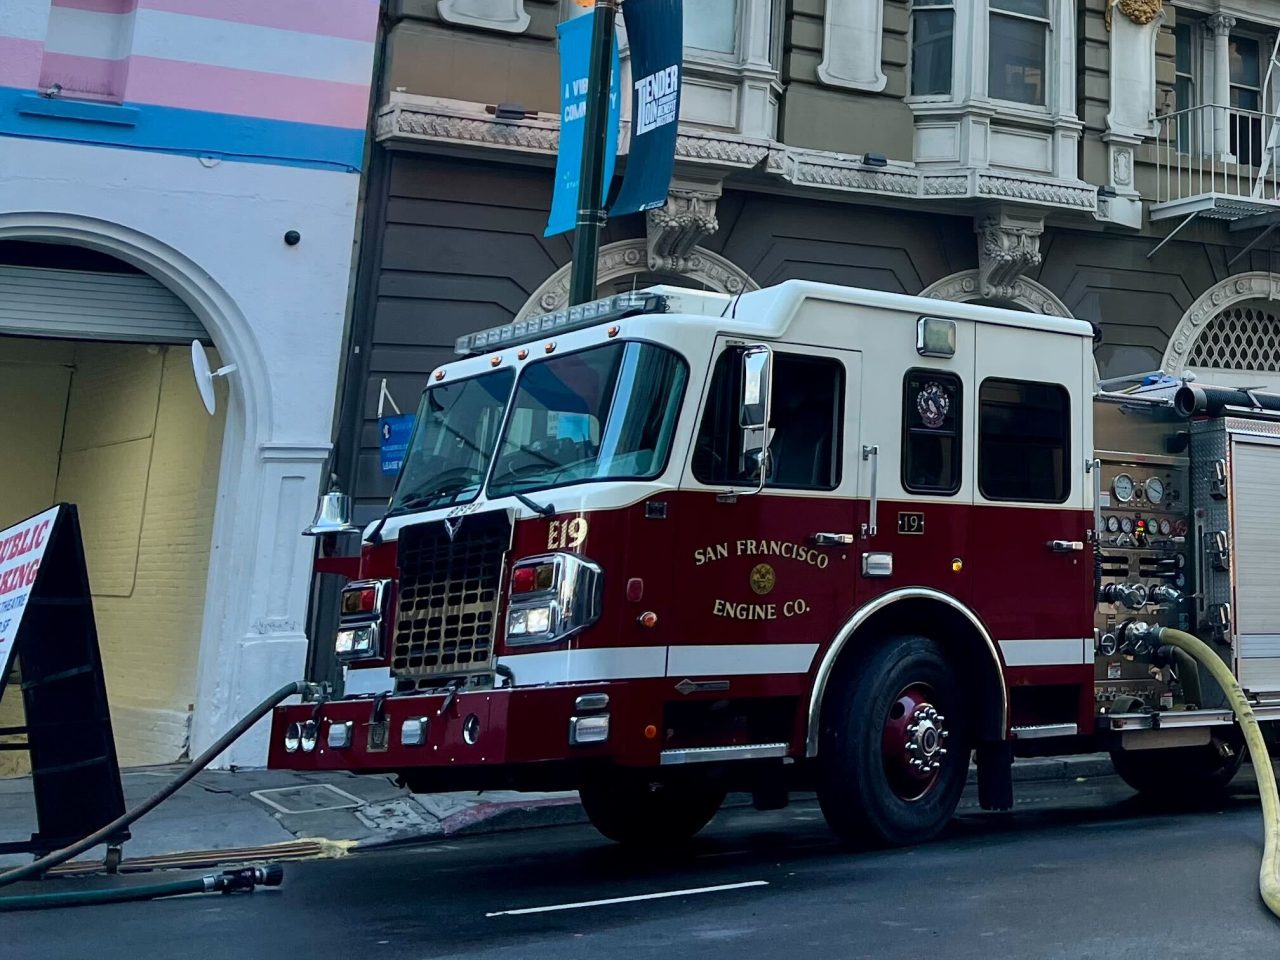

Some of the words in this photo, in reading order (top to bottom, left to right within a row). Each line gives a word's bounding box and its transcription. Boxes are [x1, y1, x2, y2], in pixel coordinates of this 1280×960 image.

[547, 517, 588, 550] E19
[903, 515, 919, 532] 19
[0, 519, 50, 565] UBLIC
[694, 542, 729, 566] SAN
[736, 539, 829, 569] FRANCISCO
[713, 599, 777, 620] ENGINE
[783, 598, 811, 617] CO.
